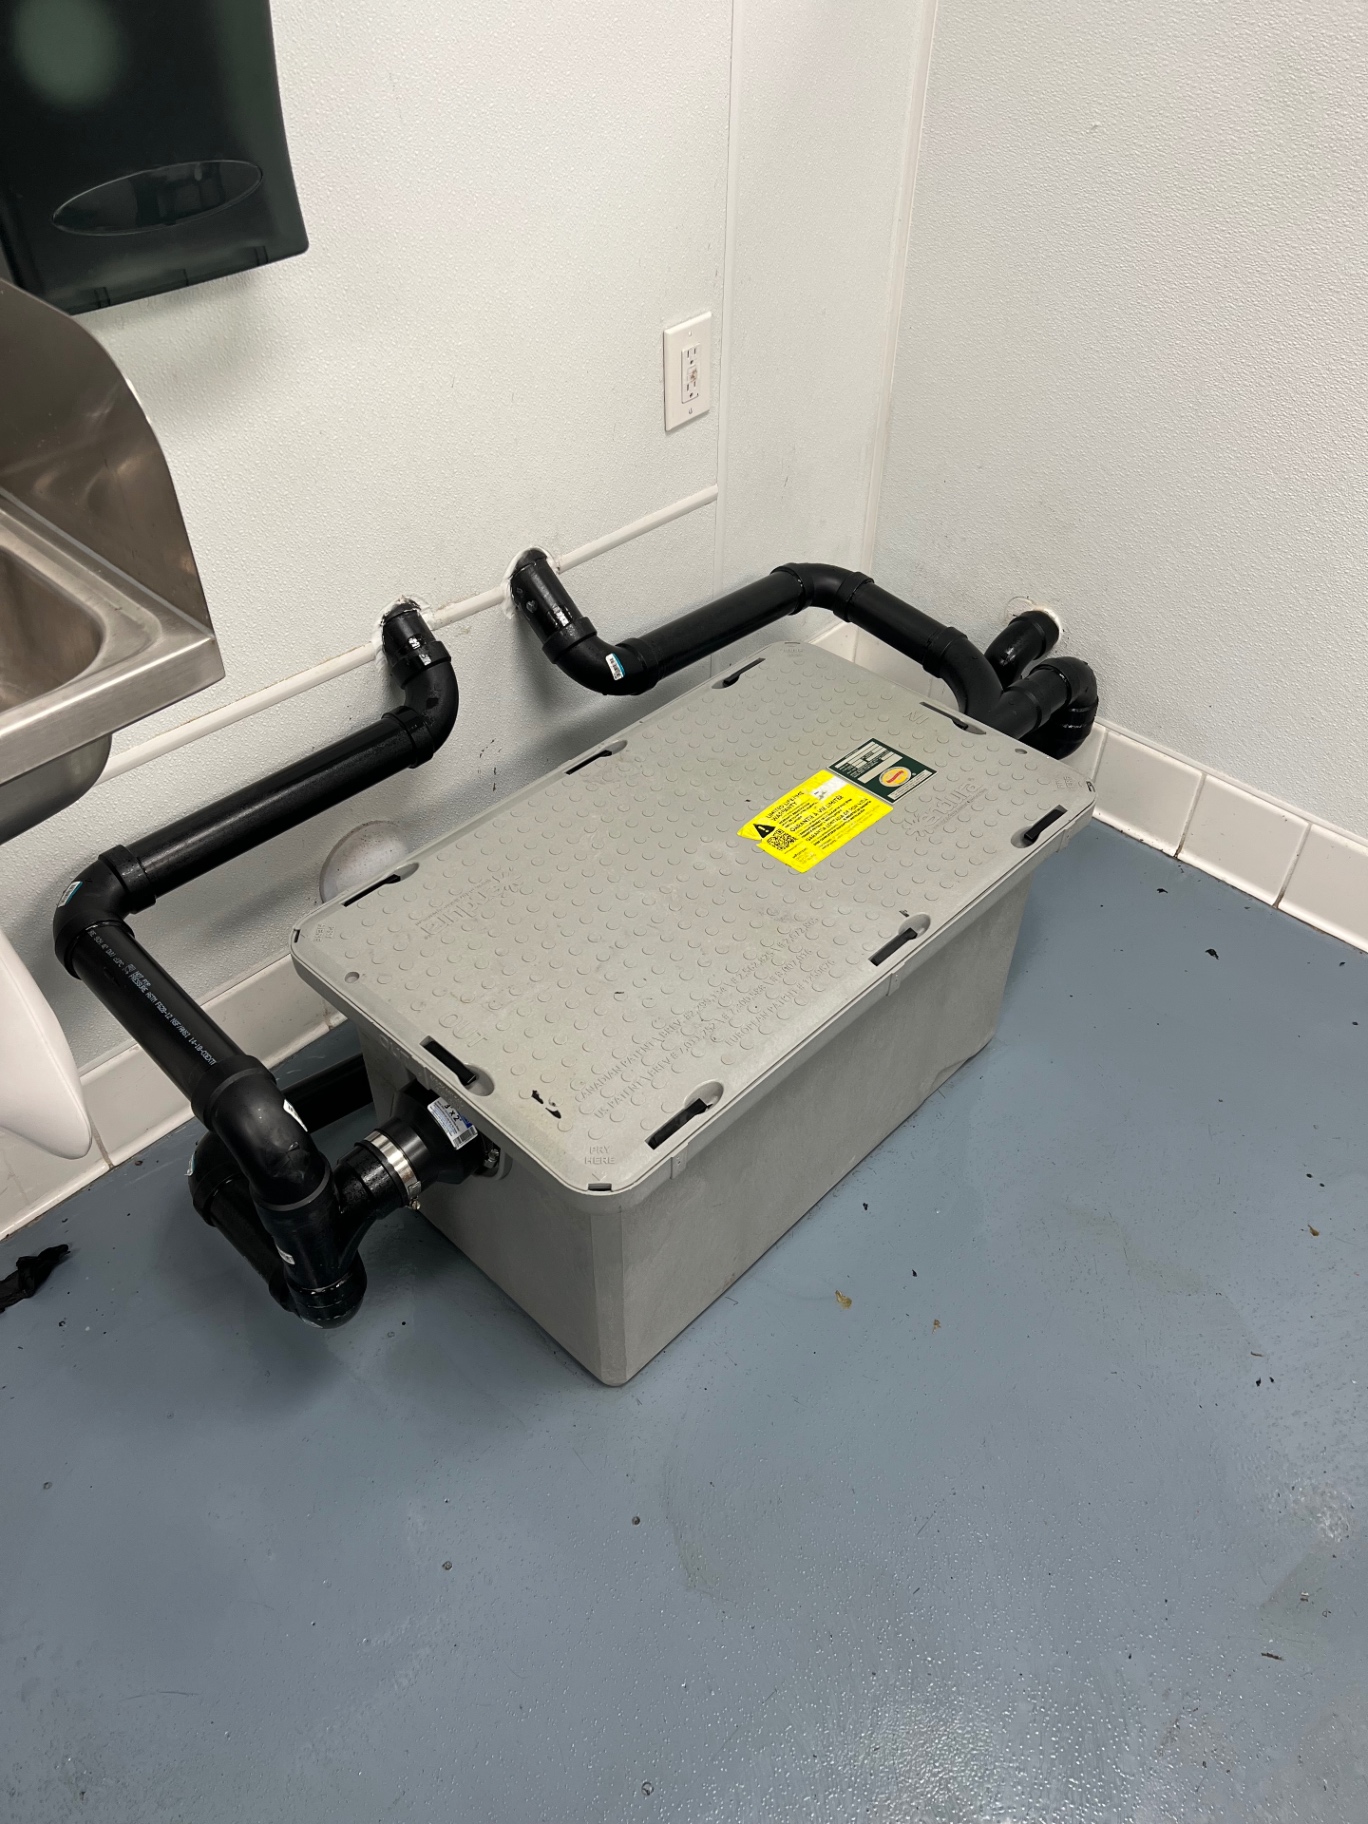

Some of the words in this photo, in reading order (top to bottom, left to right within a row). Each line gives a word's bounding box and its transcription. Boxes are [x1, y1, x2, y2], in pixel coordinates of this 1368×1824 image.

[145, 992, 158, 1003] ASTM
[439, 1014, 488, 1047] OUT
[724, 1009, 769, 1048] EUROPEAN
[767, 987, 798, 1014] PATENT
[574, 1063, 623, 1104] CANADIAN
[620, 1039, 655, 1068] PATENT
[607, 1078, 643, 1110] PATENT
[584, 1156, 616, 1165] HERE
[589, 1145, 611, 1154] PRY
